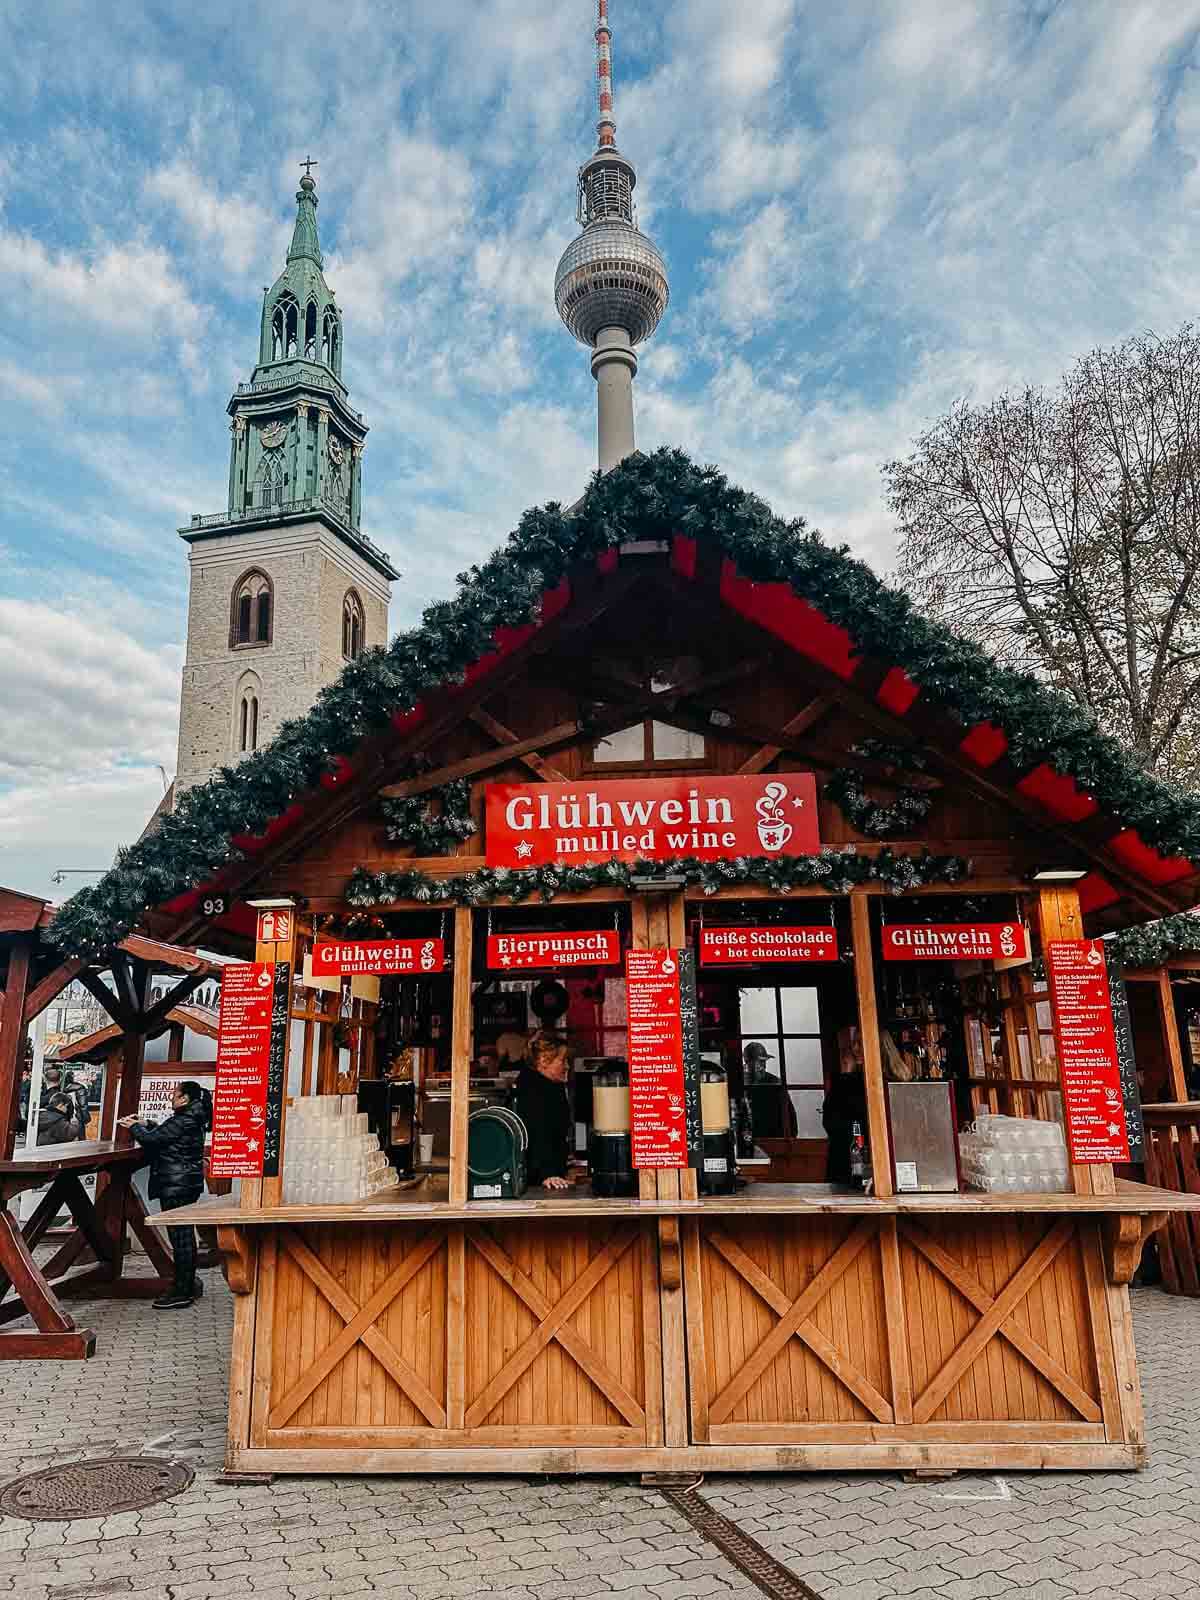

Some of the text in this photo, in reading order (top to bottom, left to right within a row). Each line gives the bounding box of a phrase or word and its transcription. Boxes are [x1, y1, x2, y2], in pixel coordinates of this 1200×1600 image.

[505, 790, 735, 831] Glühwein
[556, 828, 736, 853] mulled wine
[204, 899, 224, 915] 93
[498, 934, 608, 954] Eierpunsch
[704, 932, 833, 944] Heiße Schokolade
[892, 929, 991, 945] Glühwein
[321, 945, 413, 963] Glühwein
[552, 950, 609, 963] eggpunch
[728, 947, 811, 957] hot chocolate
[914, 944, 992, 956] mulled wine
[340, 960, 413, 972] mulled wine
[149, 1080, 181, 1091] BERLI
